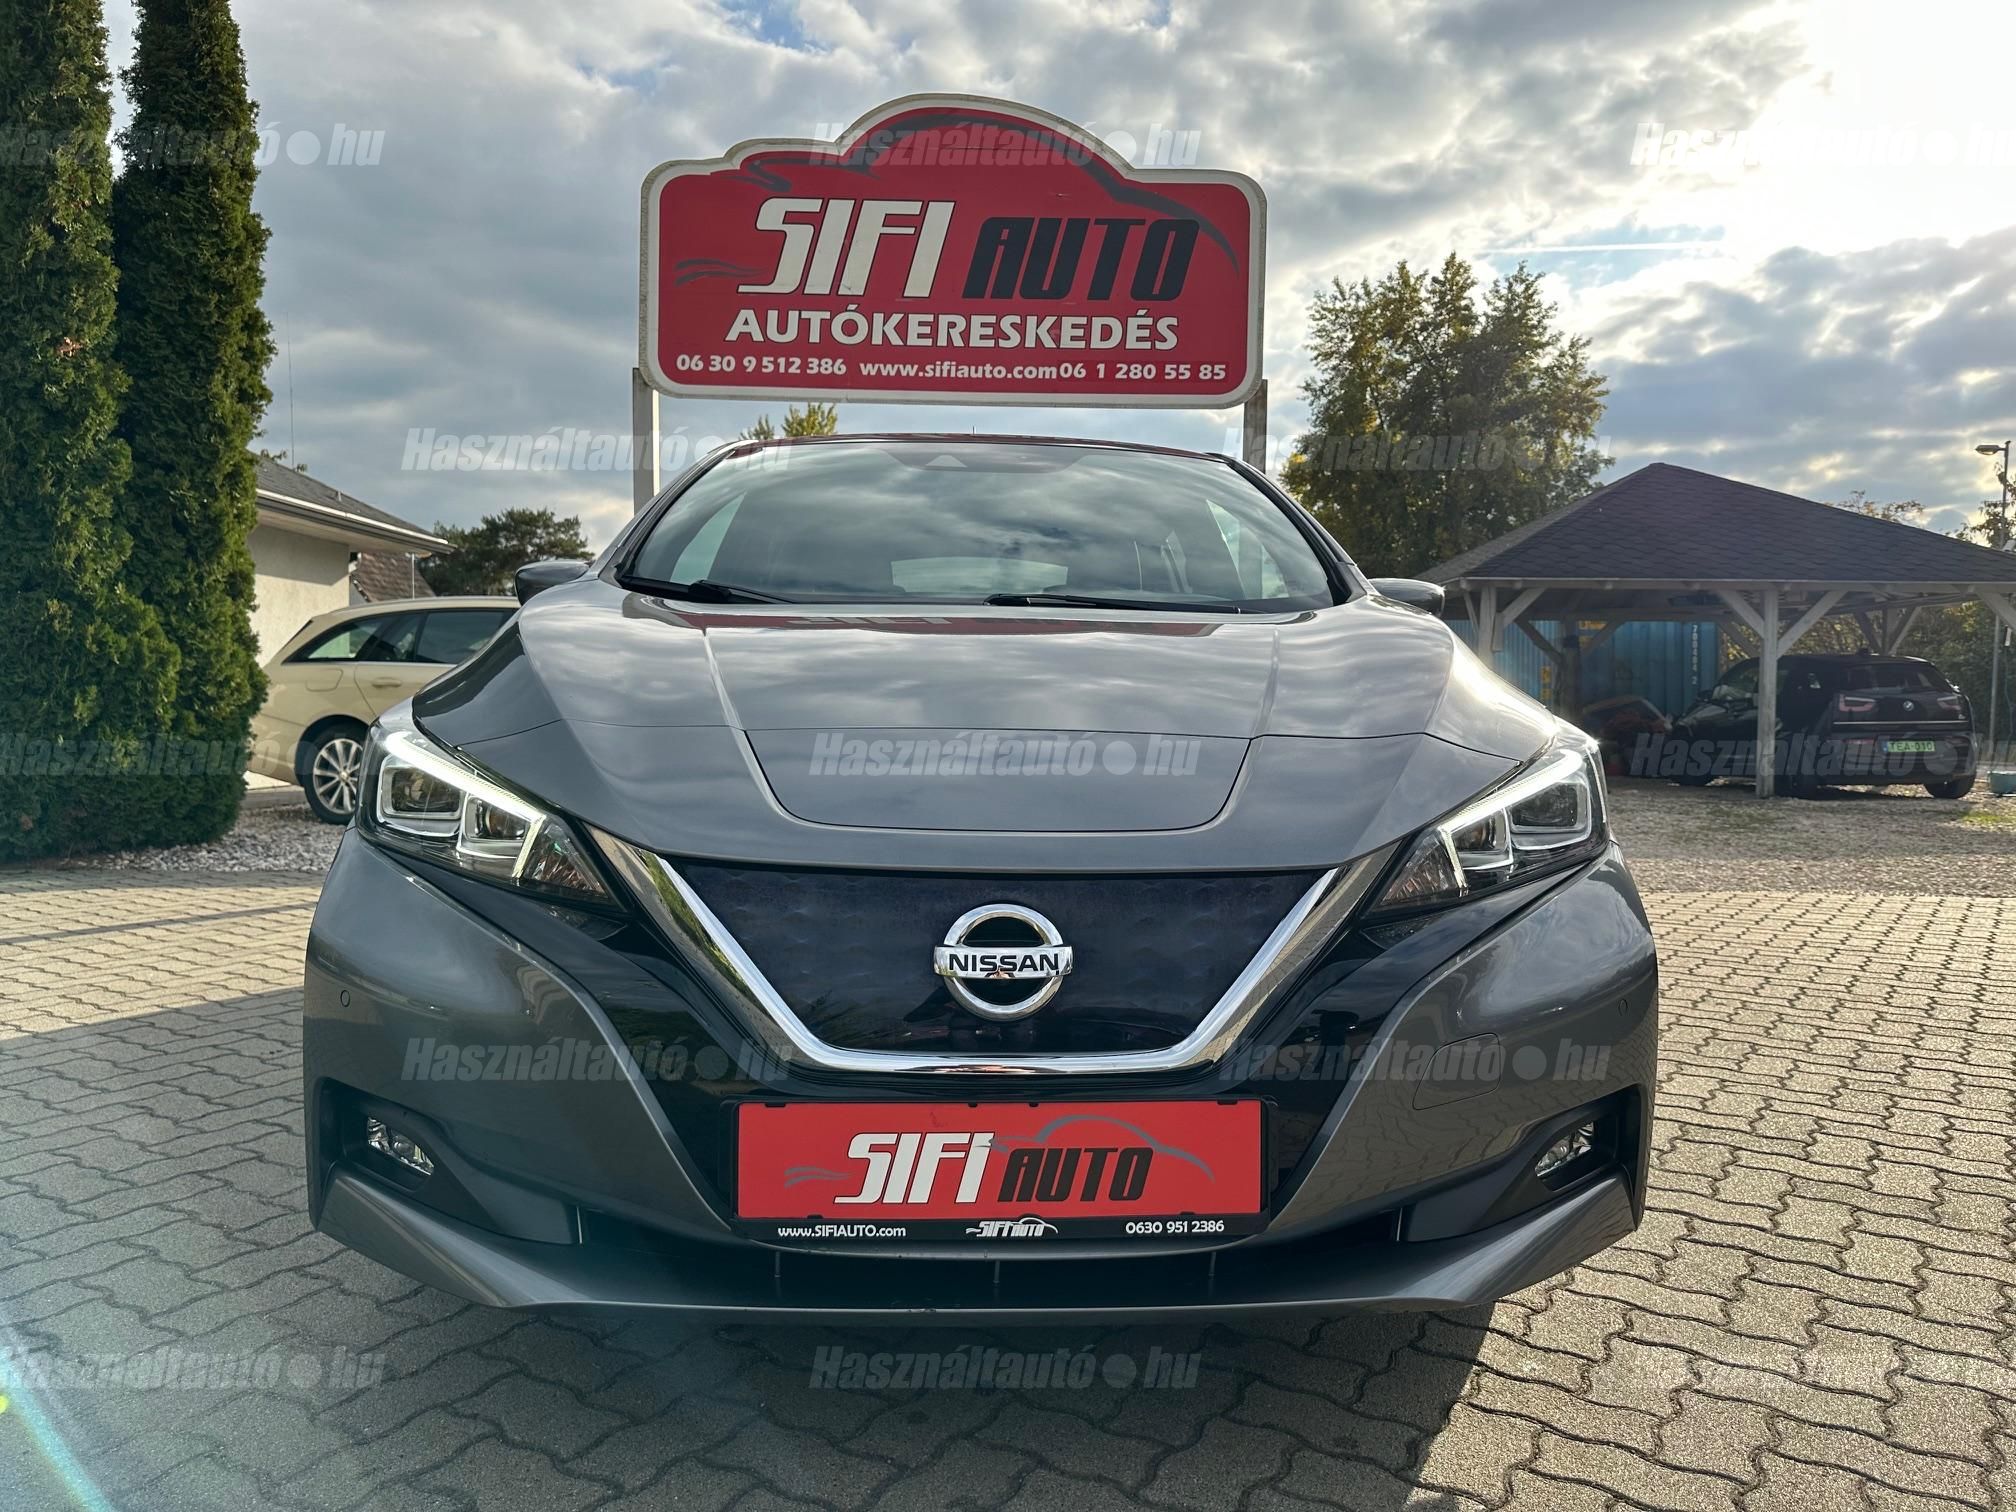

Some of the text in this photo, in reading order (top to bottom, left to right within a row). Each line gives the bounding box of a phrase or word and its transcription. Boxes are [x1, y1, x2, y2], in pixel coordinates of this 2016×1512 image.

[737, 196, 1201, 300] SIFI AUTO
[725, 305, 1179, 351] AUTÓKERESKEDÉS
[676, 354, 1226, 380] 06 30 9 512 386 www.sifiauto.com 06 1 280 55 85
[949, 953, 1059, 972] NISSAN
[833, 1131, 1154, 1205] SIFI AUTO
[777, 1224, 906, 1237] www.SIFIAUTO.com
[1125, 1220, 1224, 1234] 0630 951 2386
